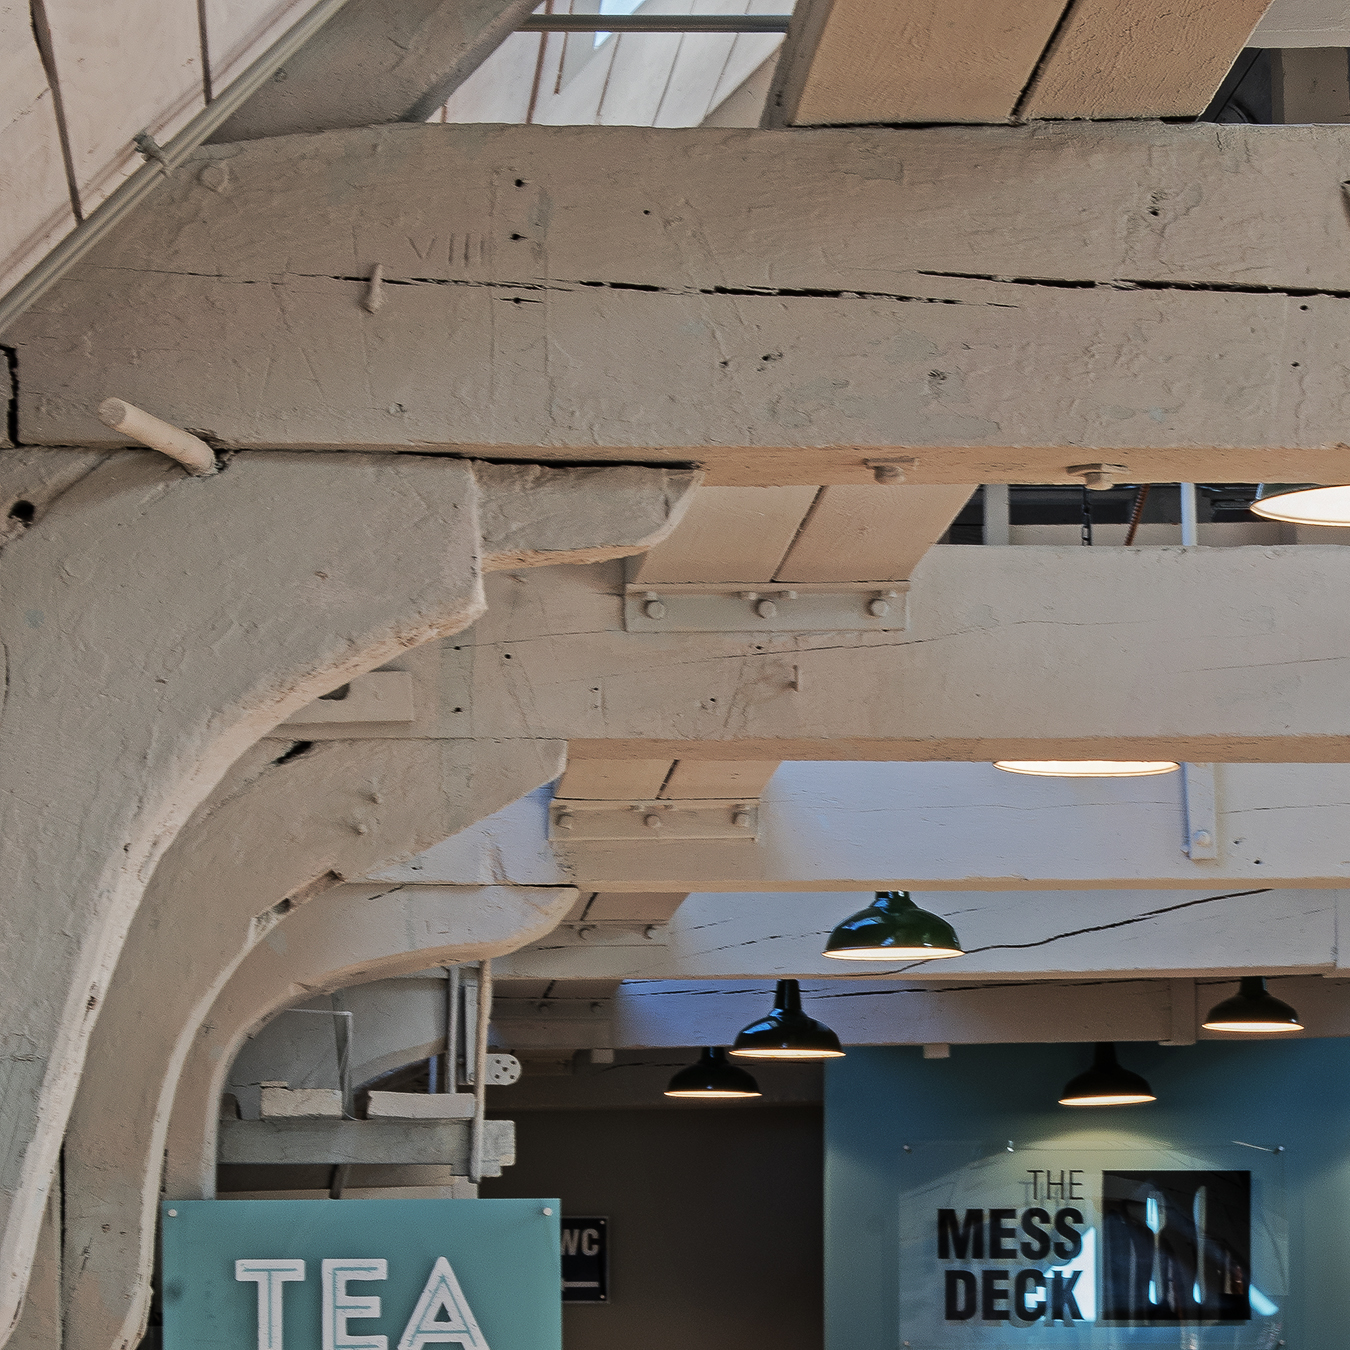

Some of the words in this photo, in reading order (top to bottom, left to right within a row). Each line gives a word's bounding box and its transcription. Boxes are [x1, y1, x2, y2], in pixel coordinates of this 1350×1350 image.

[1026, 1169, 1085, 1201] THE
[561, 1228, 600, 1256] WC
[937, 1207, 1085, 1261] MESS
[944, 1268, 1086, 1322] DECK
